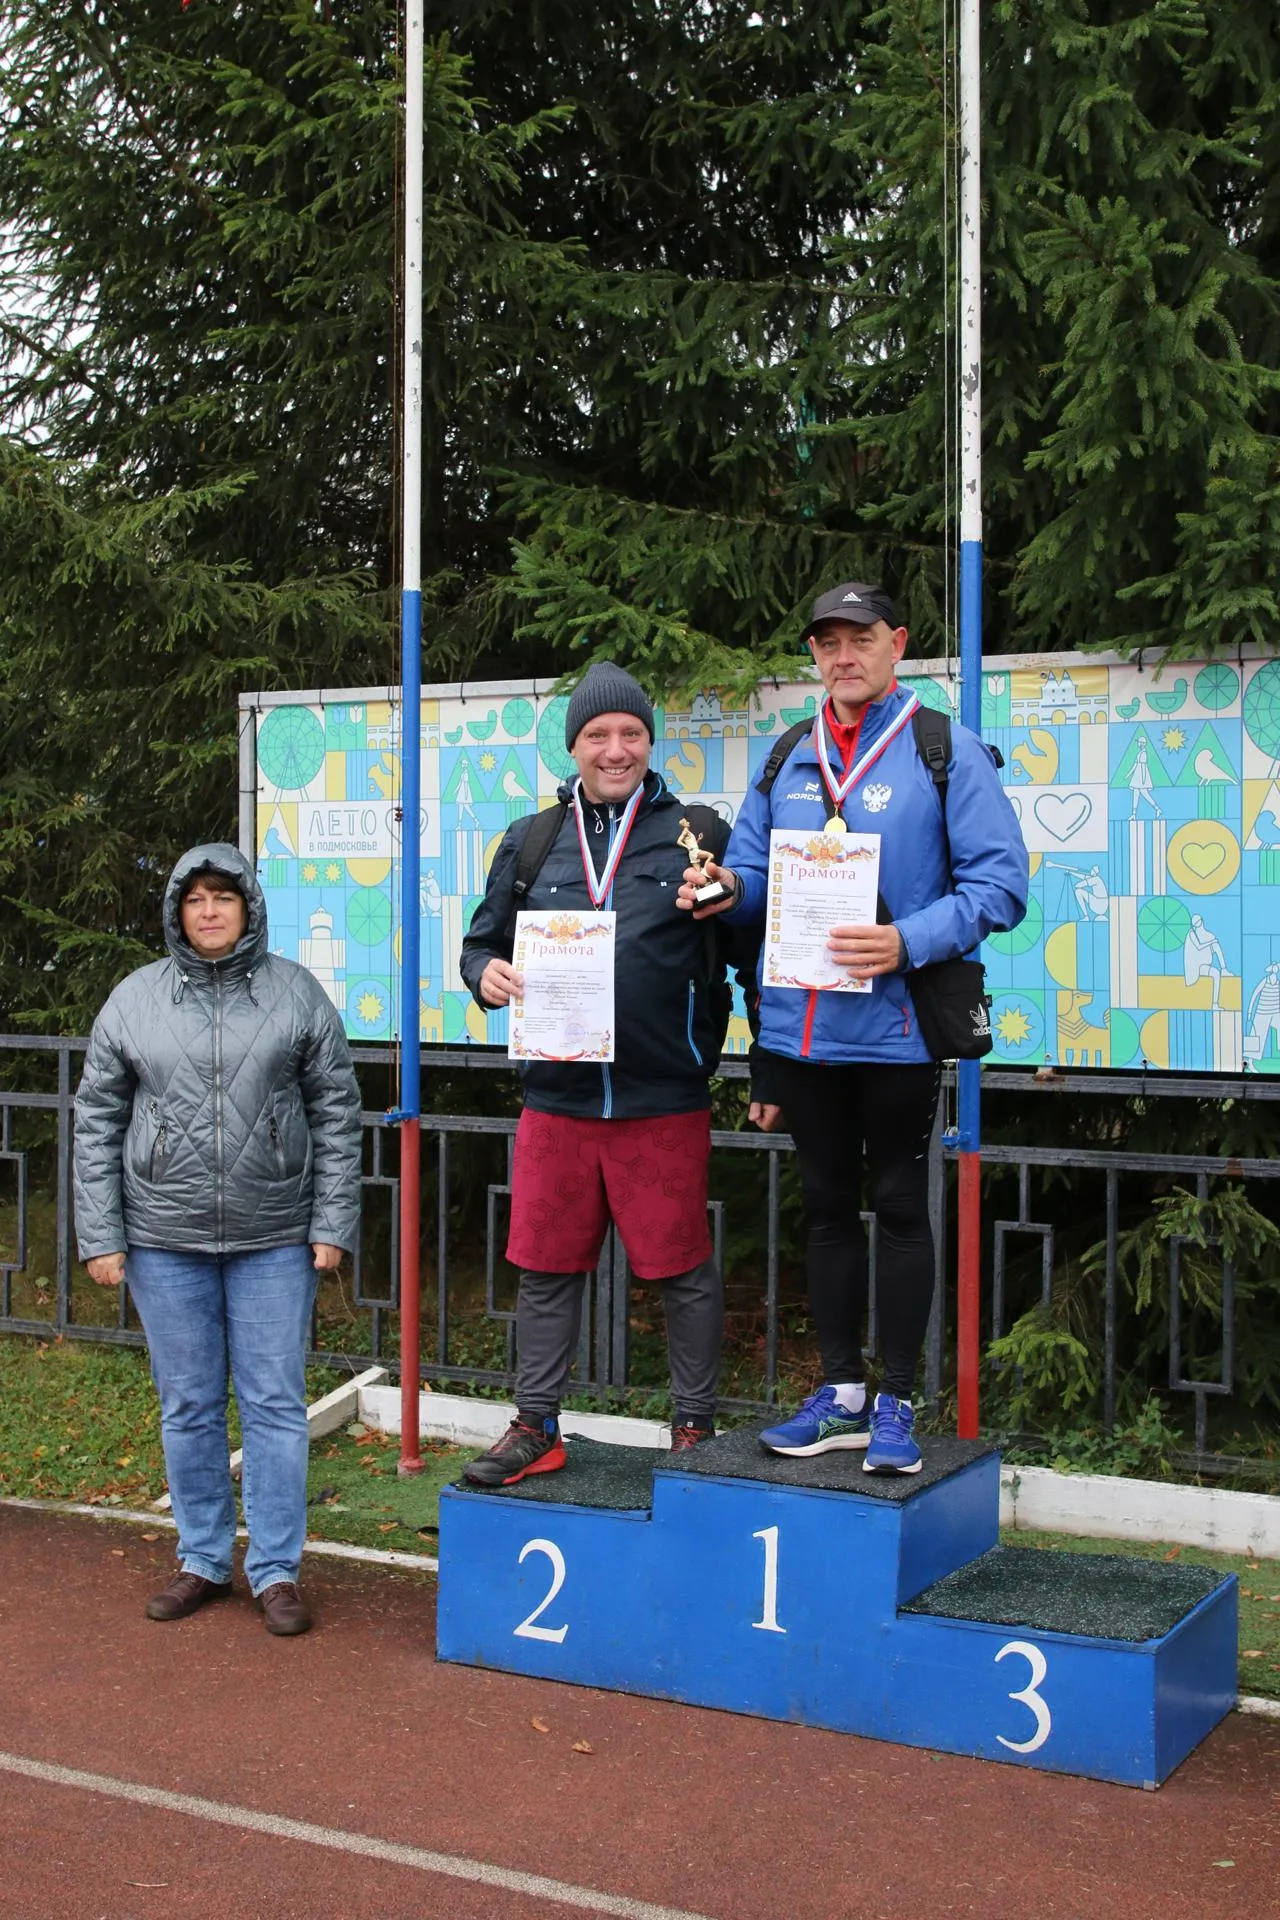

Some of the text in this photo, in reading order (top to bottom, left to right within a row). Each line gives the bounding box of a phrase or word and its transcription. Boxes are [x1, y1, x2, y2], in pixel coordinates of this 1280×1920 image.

[786, 793, 823, 803] NORDS
[309, 809, 377, 836] ЛЕТО
[789, 863, 856, 881] Грамота
[532, 941, 594, 958] Грамота
[513, 1538, 569, 1644] 2
[752, 1525, 787, 1634] 1
[994, 1640, 1051, 1754] 3
